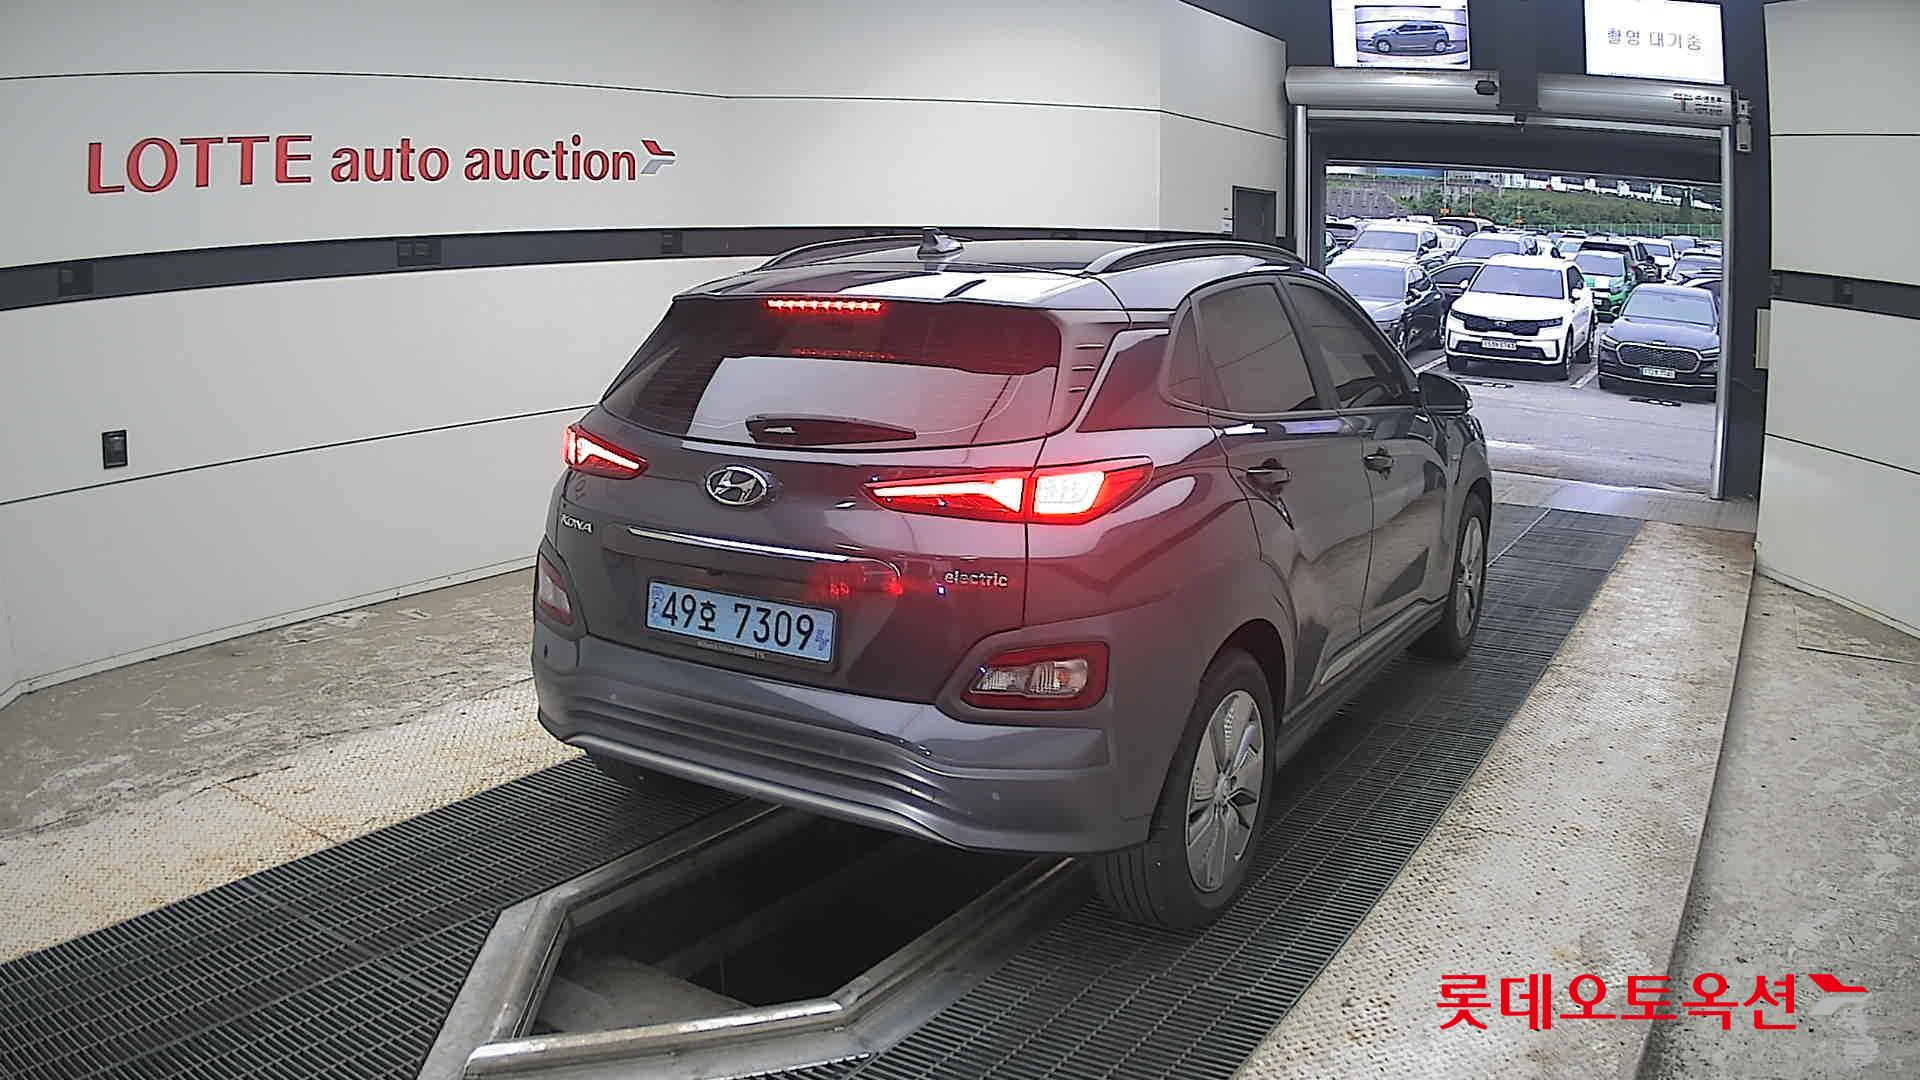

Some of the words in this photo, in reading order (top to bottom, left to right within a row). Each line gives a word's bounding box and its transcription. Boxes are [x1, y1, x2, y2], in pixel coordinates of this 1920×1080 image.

[87, 134, 313, 194] LOTTE
[330, 138, 450, 183] auto
[463, 133, 638, 182] auction
[944, 570, 1008, 587] electric
[662, 591, 717, 633] 49호
[733, 602, 815, 651] 7309
